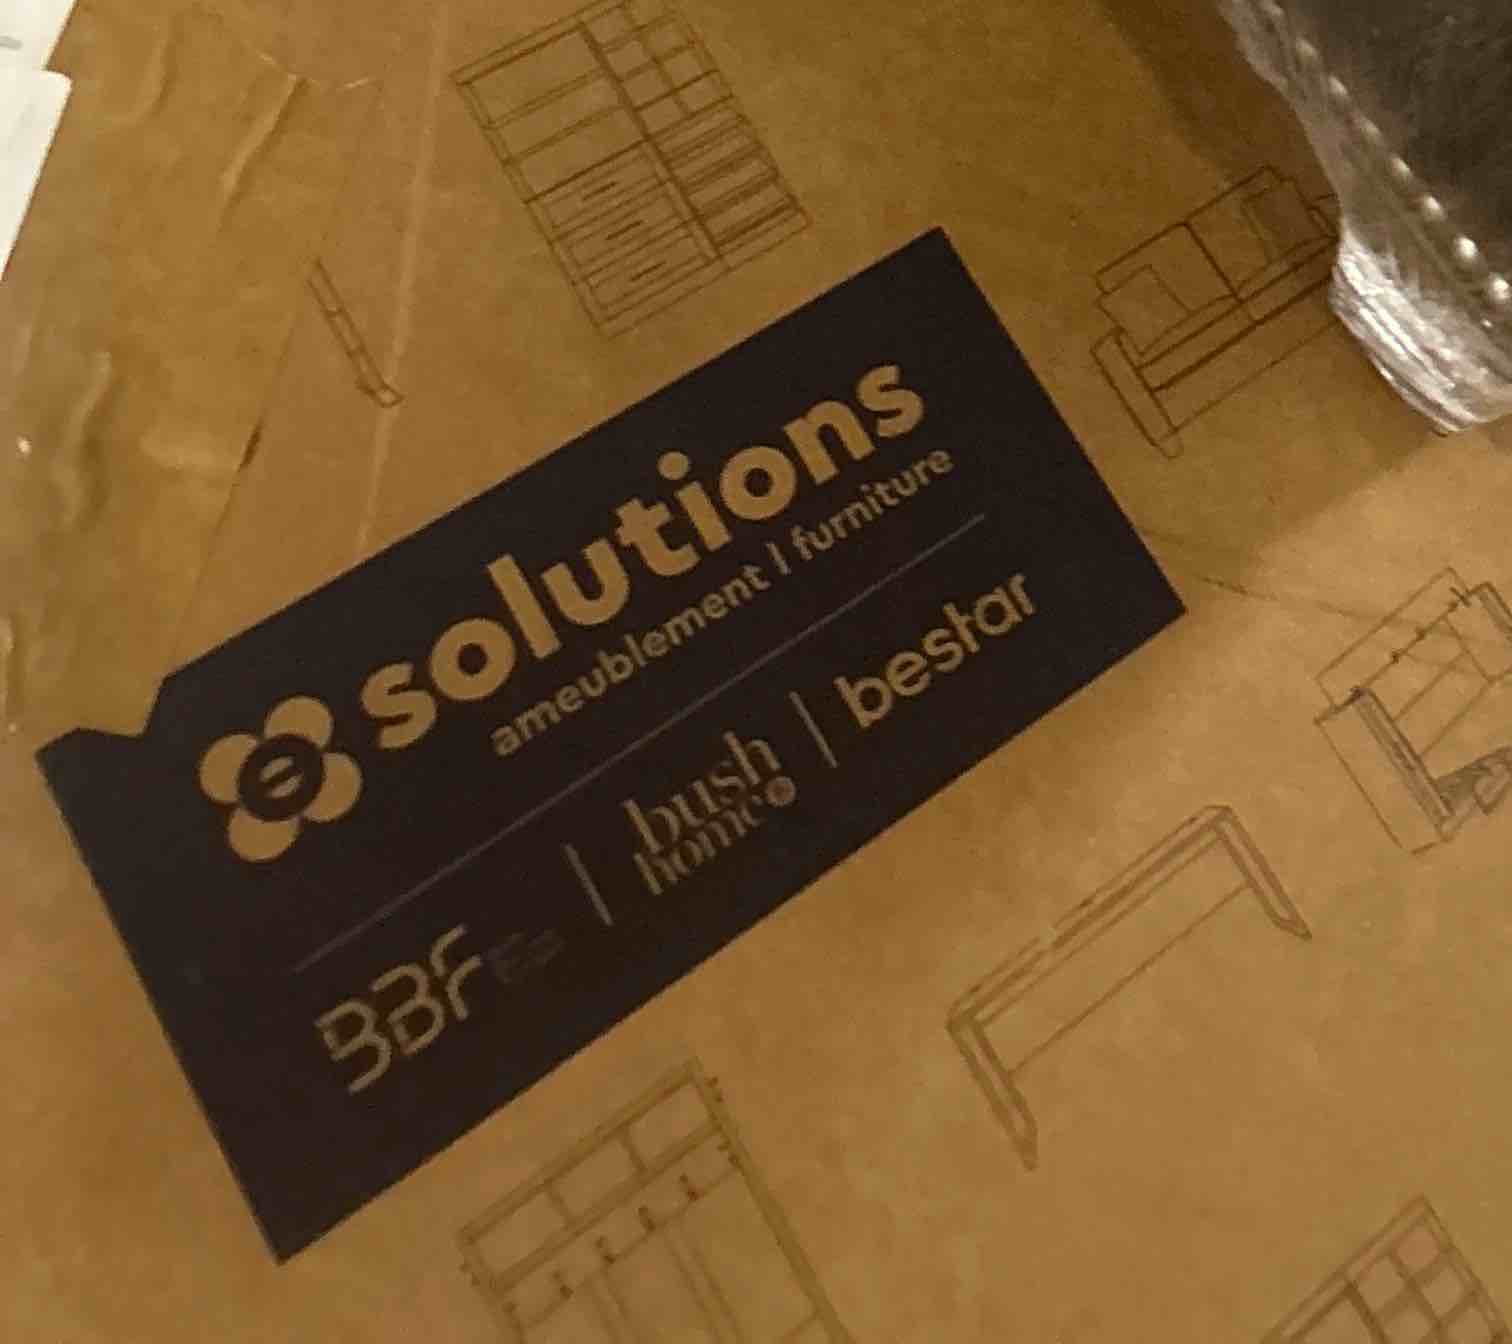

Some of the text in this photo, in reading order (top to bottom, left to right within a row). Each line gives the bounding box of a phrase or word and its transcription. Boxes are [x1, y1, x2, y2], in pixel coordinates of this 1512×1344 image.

[360, 363, 925, 751] solutions
[490, 449, 955, 757] ameublement furniture
[621, 730, 782, 855] bush
[831, 572, 1037, 729] bestar
